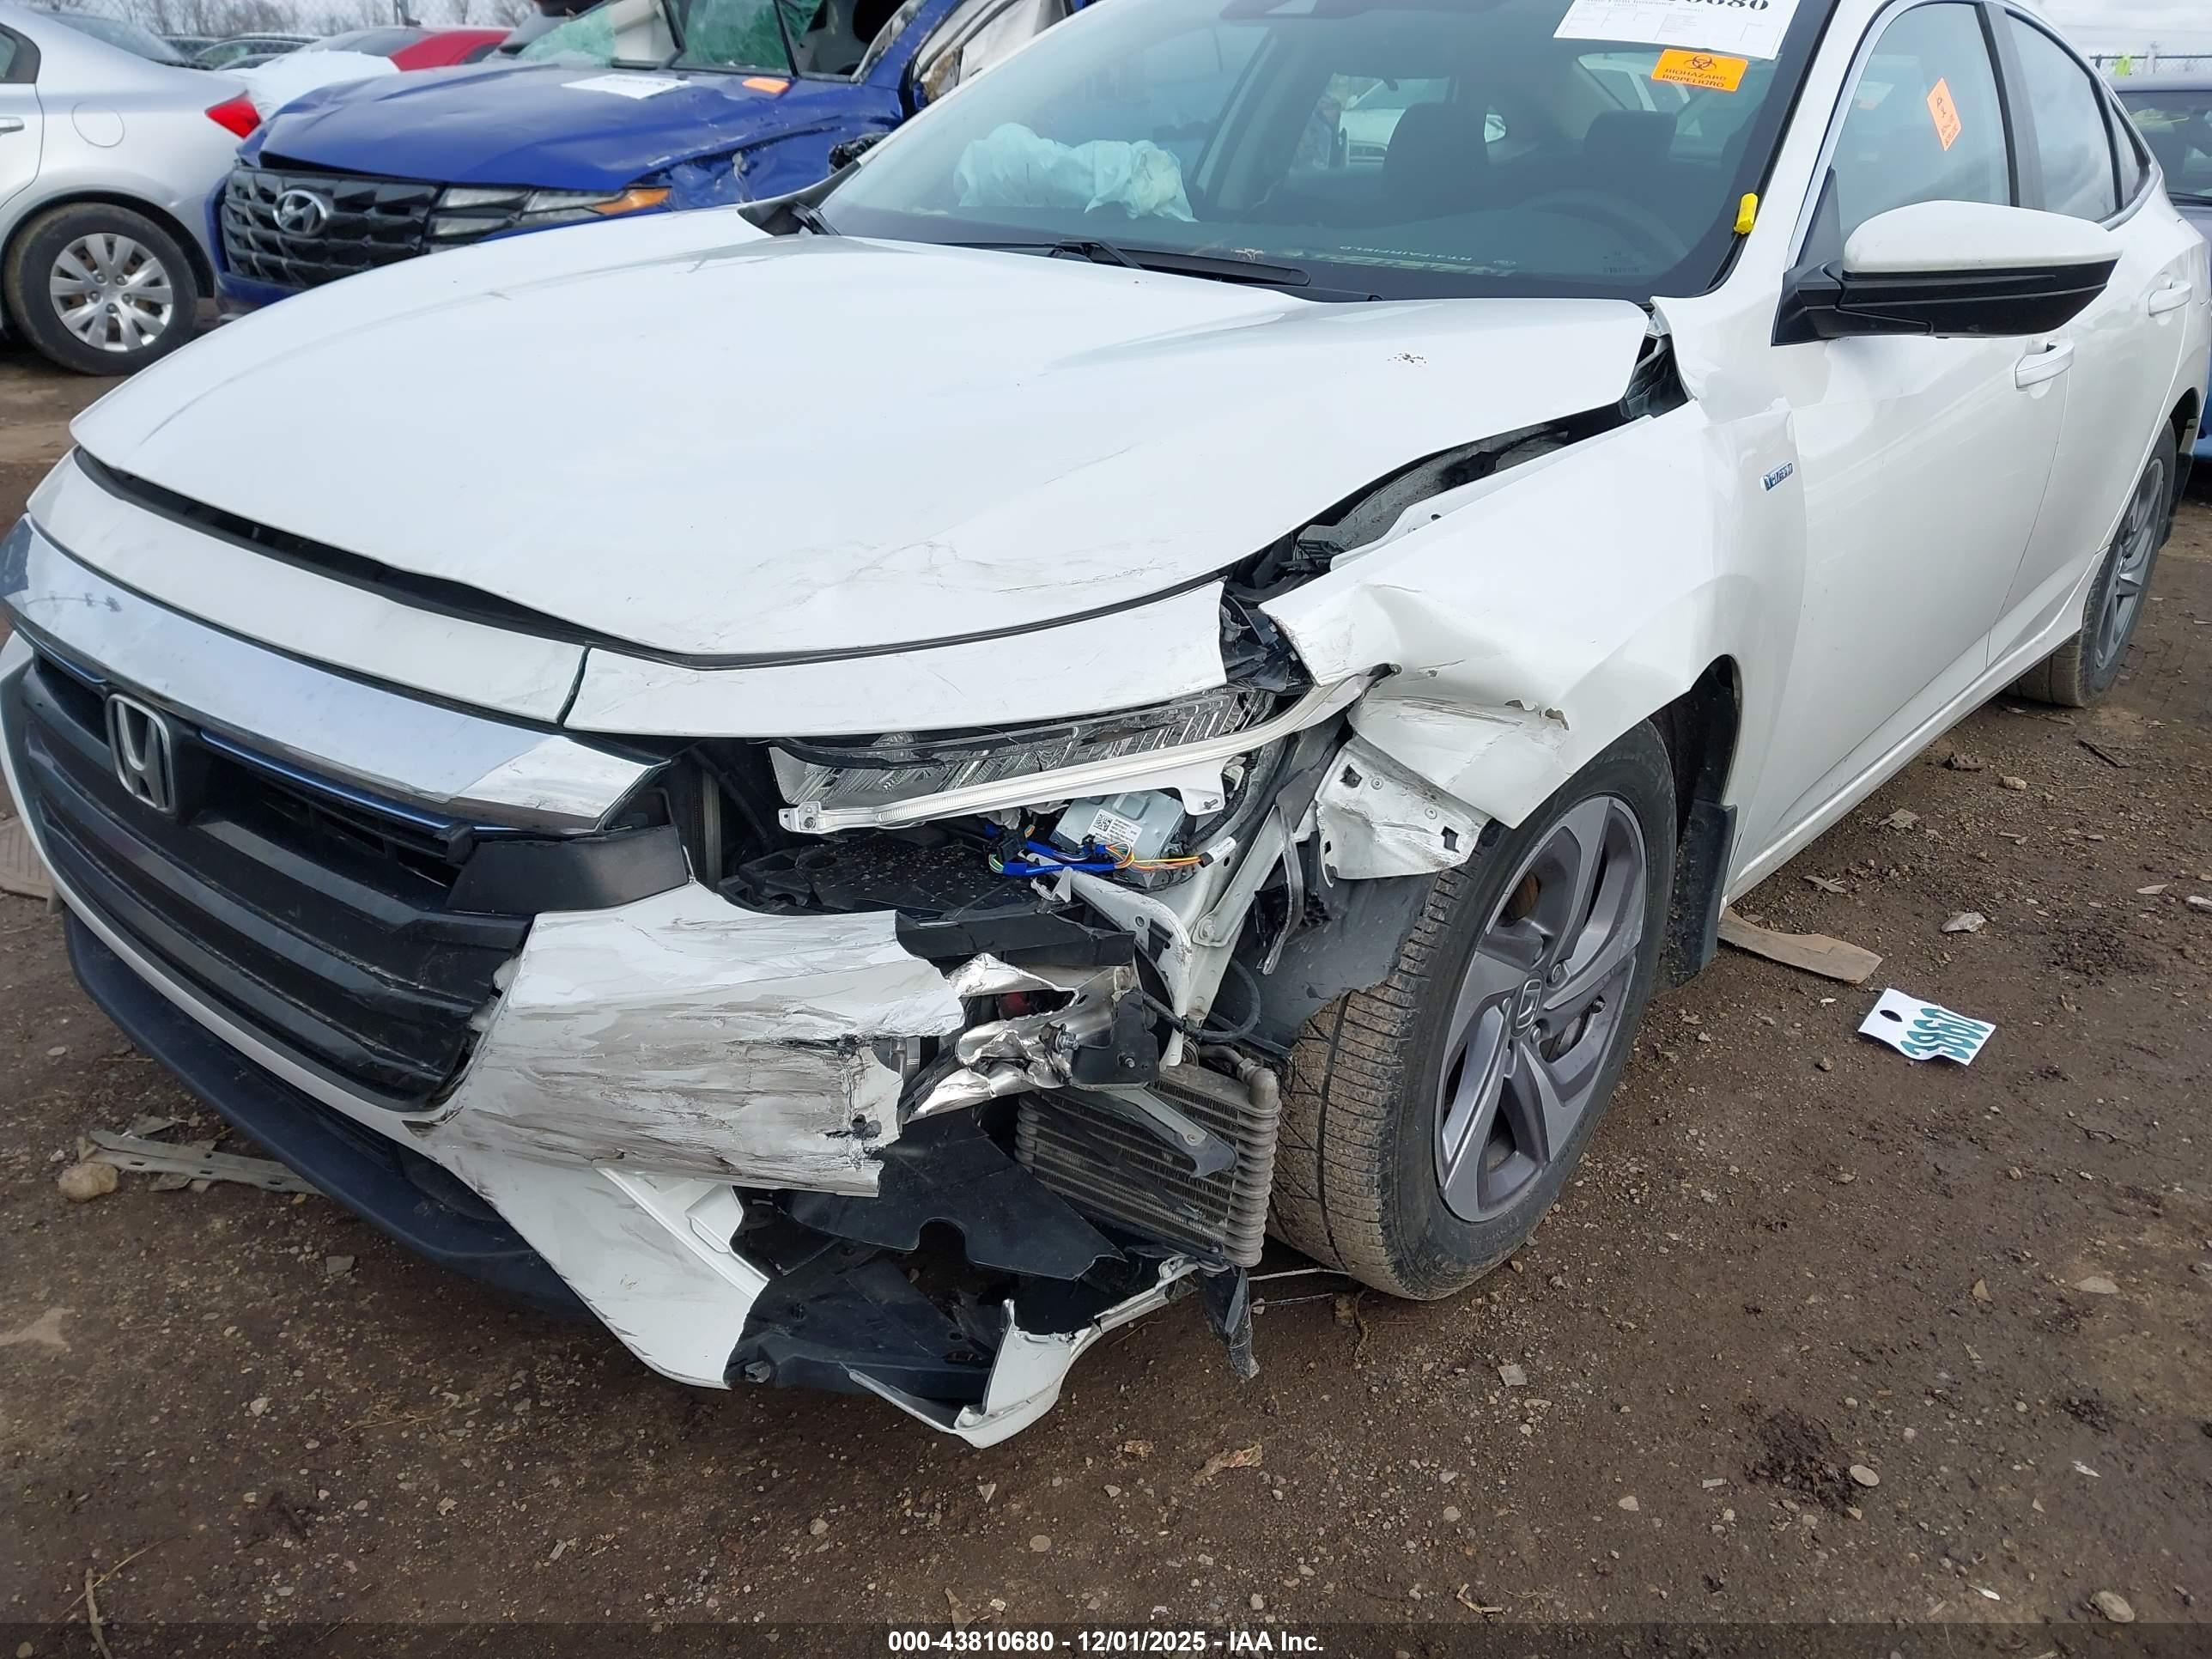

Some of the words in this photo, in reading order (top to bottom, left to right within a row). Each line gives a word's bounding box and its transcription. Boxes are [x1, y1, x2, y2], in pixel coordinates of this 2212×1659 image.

[1662, 74, 1724, 88] BIOPELIGRO
[1664, 68, 1727, 82] BIOHAZARD
[1899, 1007, 1990, 1060] 3860
